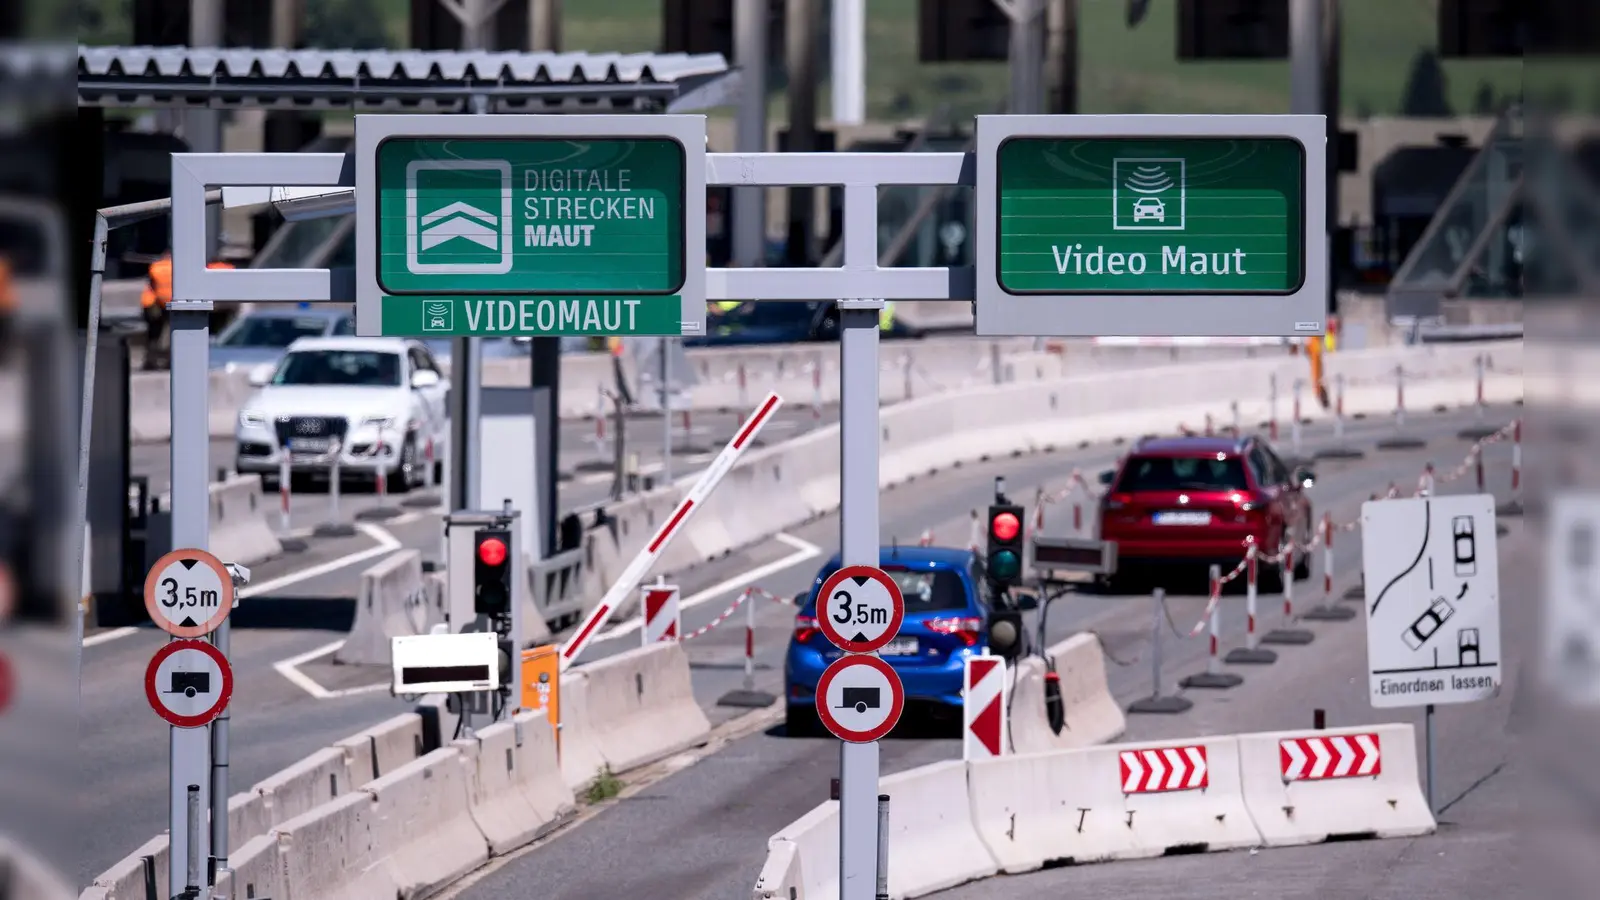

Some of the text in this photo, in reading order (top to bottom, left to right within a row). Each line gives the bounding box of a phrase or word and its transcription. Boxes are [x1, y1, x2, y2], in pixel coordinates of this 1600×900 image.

[524, 169, 631, 192] DIGITALE
[524, 197, 655, 220] STRECKEN
[524, 224, 595, 247] MAUT
[1052, 244, 1247, 275] Video Maut
[464, 300, 641, 330] VIDEOMAUT
[1380, 675, 1492, 695] Einordnen lassen
